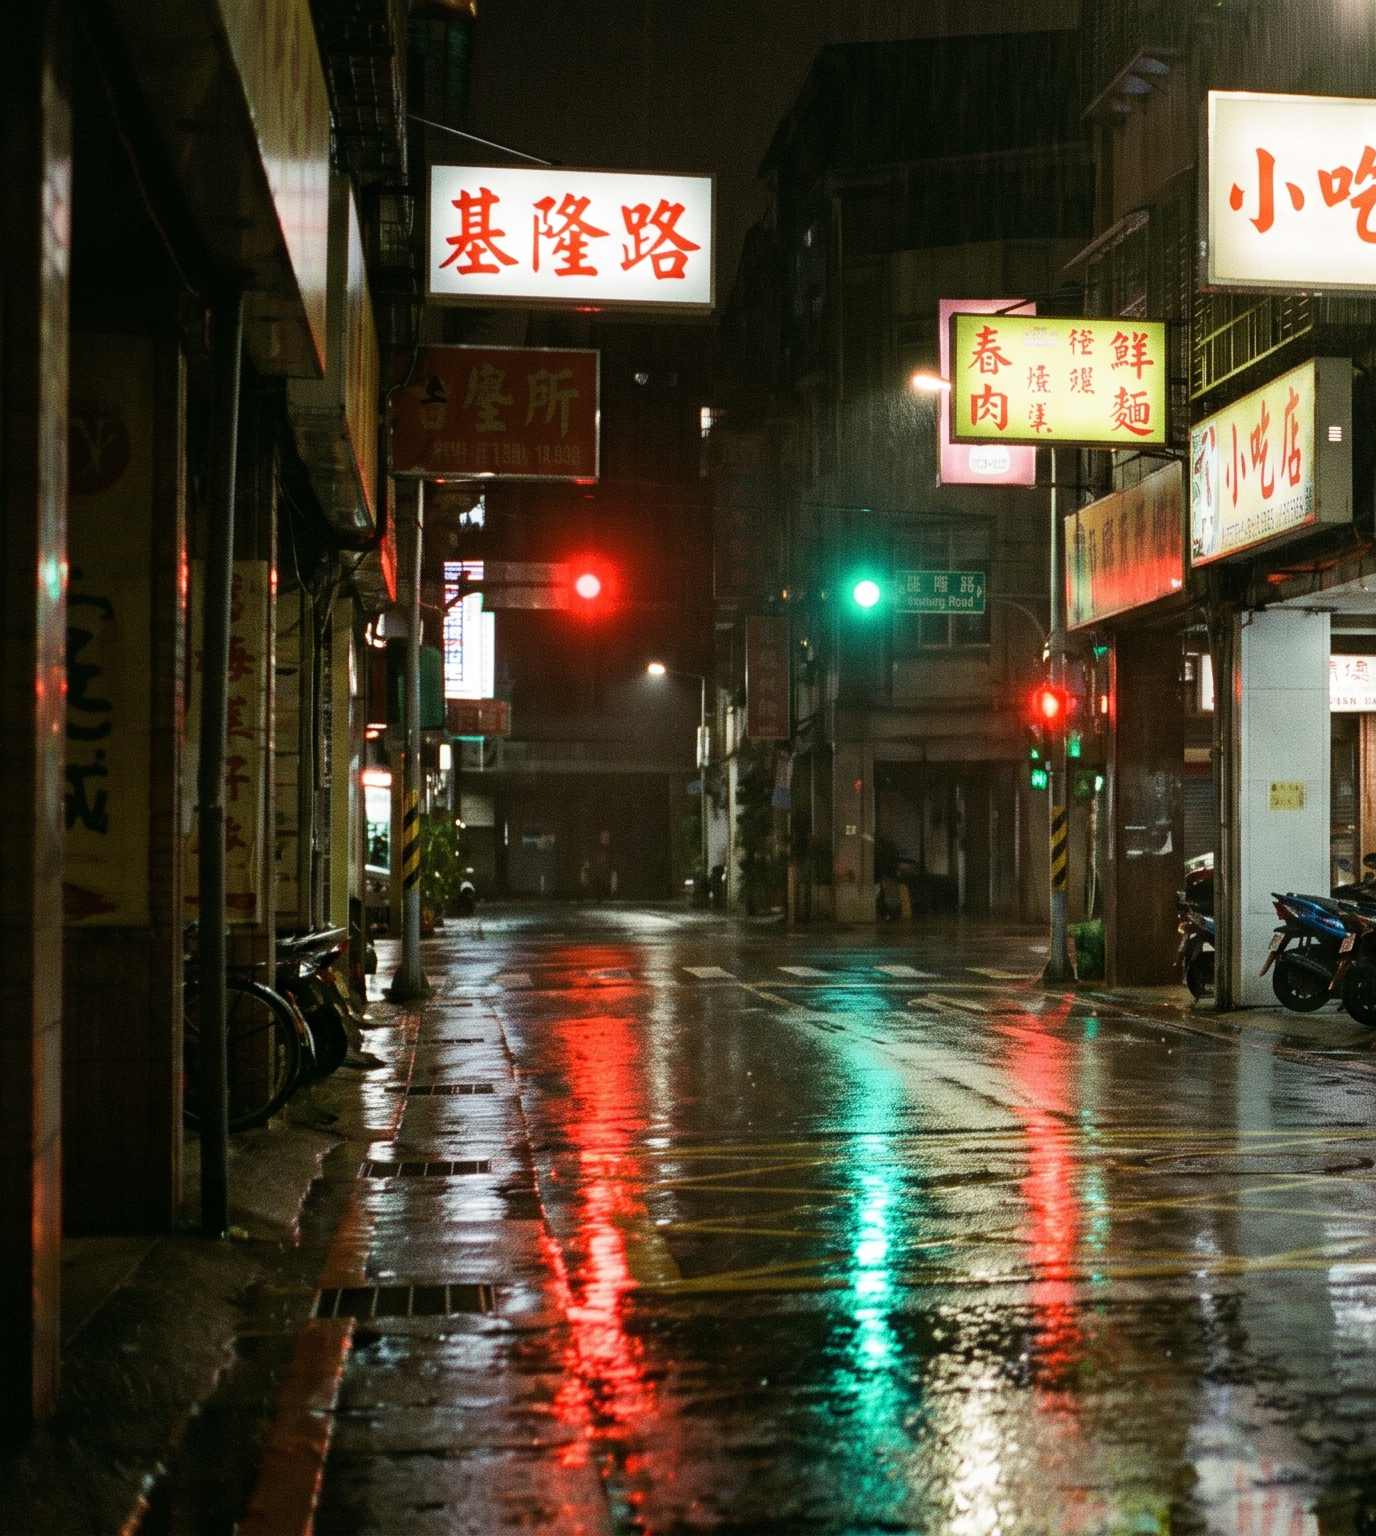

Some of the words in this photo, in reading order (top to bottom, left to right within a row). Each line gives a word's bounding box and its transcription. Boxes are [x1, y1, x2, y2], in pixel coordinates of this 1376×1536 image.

[438, 186, 702, 281] 基隆路
[1225, 385, 1303, 508] 小吃店
